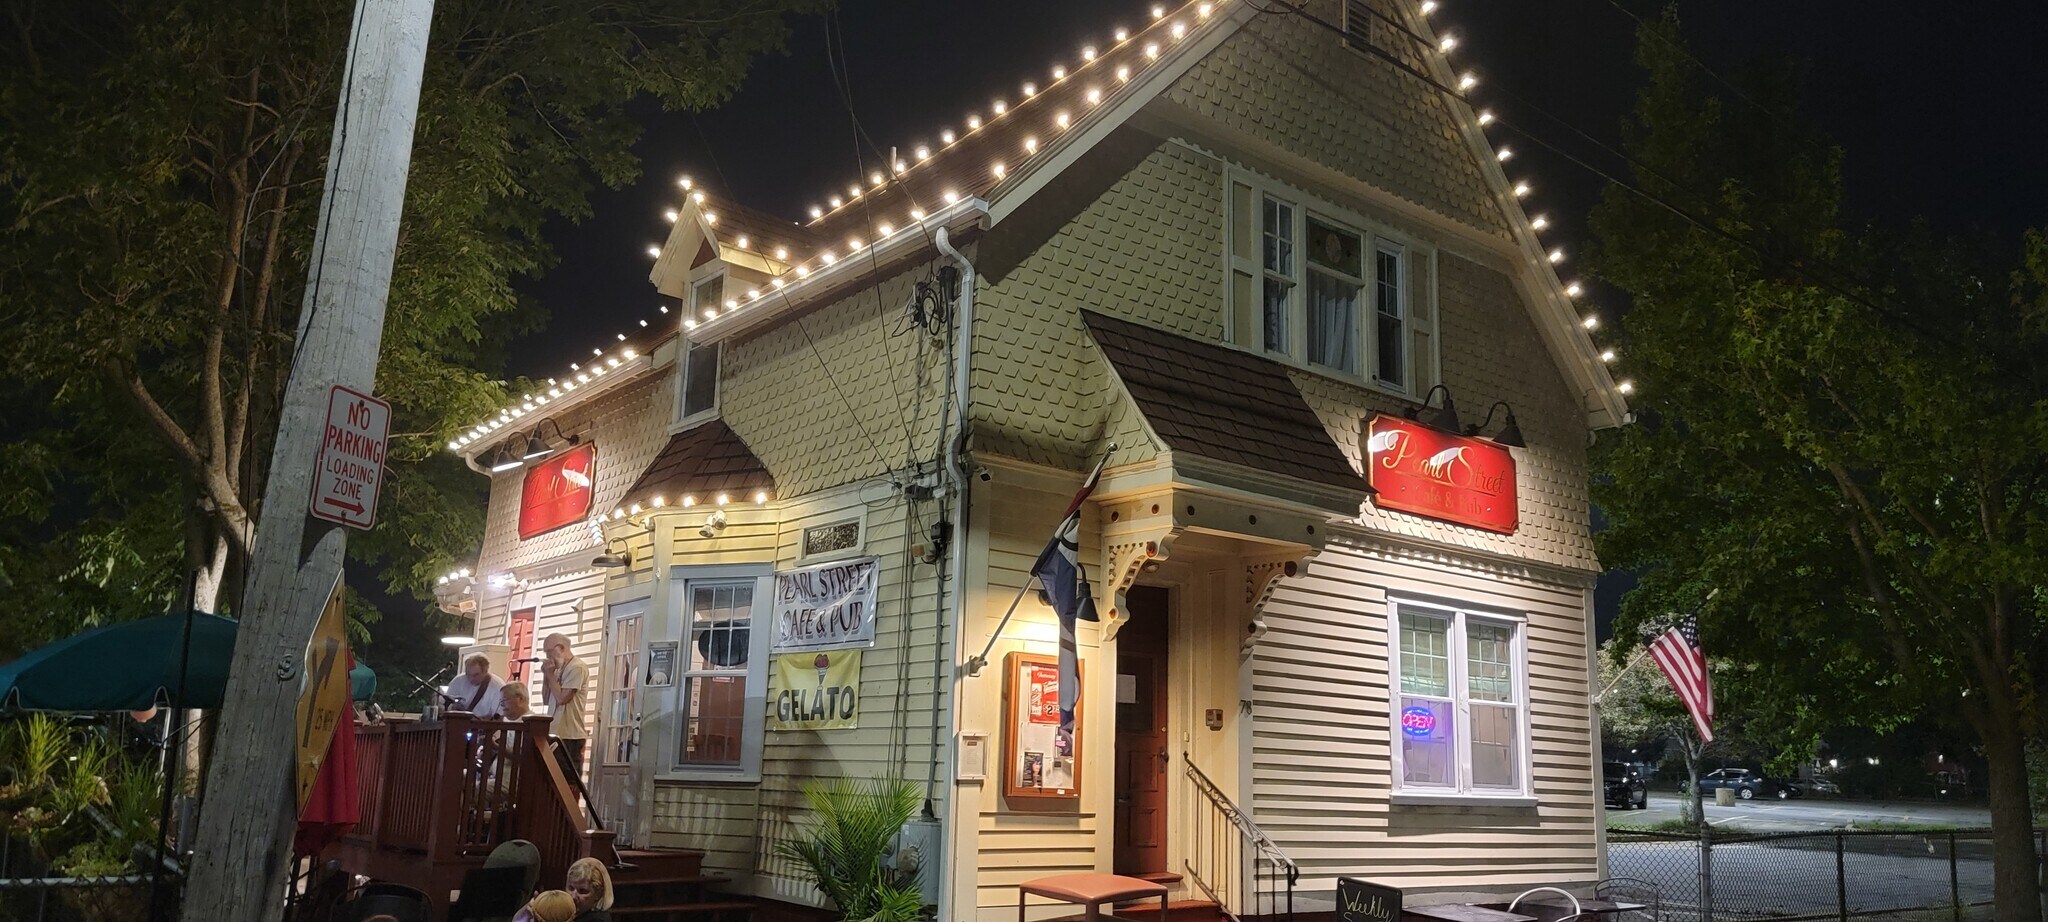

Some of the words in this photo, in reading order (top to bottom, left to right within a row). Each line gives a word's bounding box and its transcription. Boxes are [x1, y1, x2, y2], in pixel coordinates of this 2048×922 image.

[347, 401, 371, 431] NO
[326, 424, 382, 464] PARKING
[326, 455, 375, 485] LOADING
[1382, 429, 1444, 479] Pearl
[1446, 445, 1505, 495] Street
[332, 477, 363, 501] ZONE
[1445, 490, 1455, 509] &
[778, 572, 817, 602] PEARL
[818, 561, 875, 599] STREET
[816, 610, 827, 635] &
[830, 601, 863, 634] PUB
[776, 685, 856, 722] GELATO
[1239, 699, 1253, 715] 78
[1402, 712, 1435, 729] OPEN
[1342, 887, 1395, 922] Weekly
